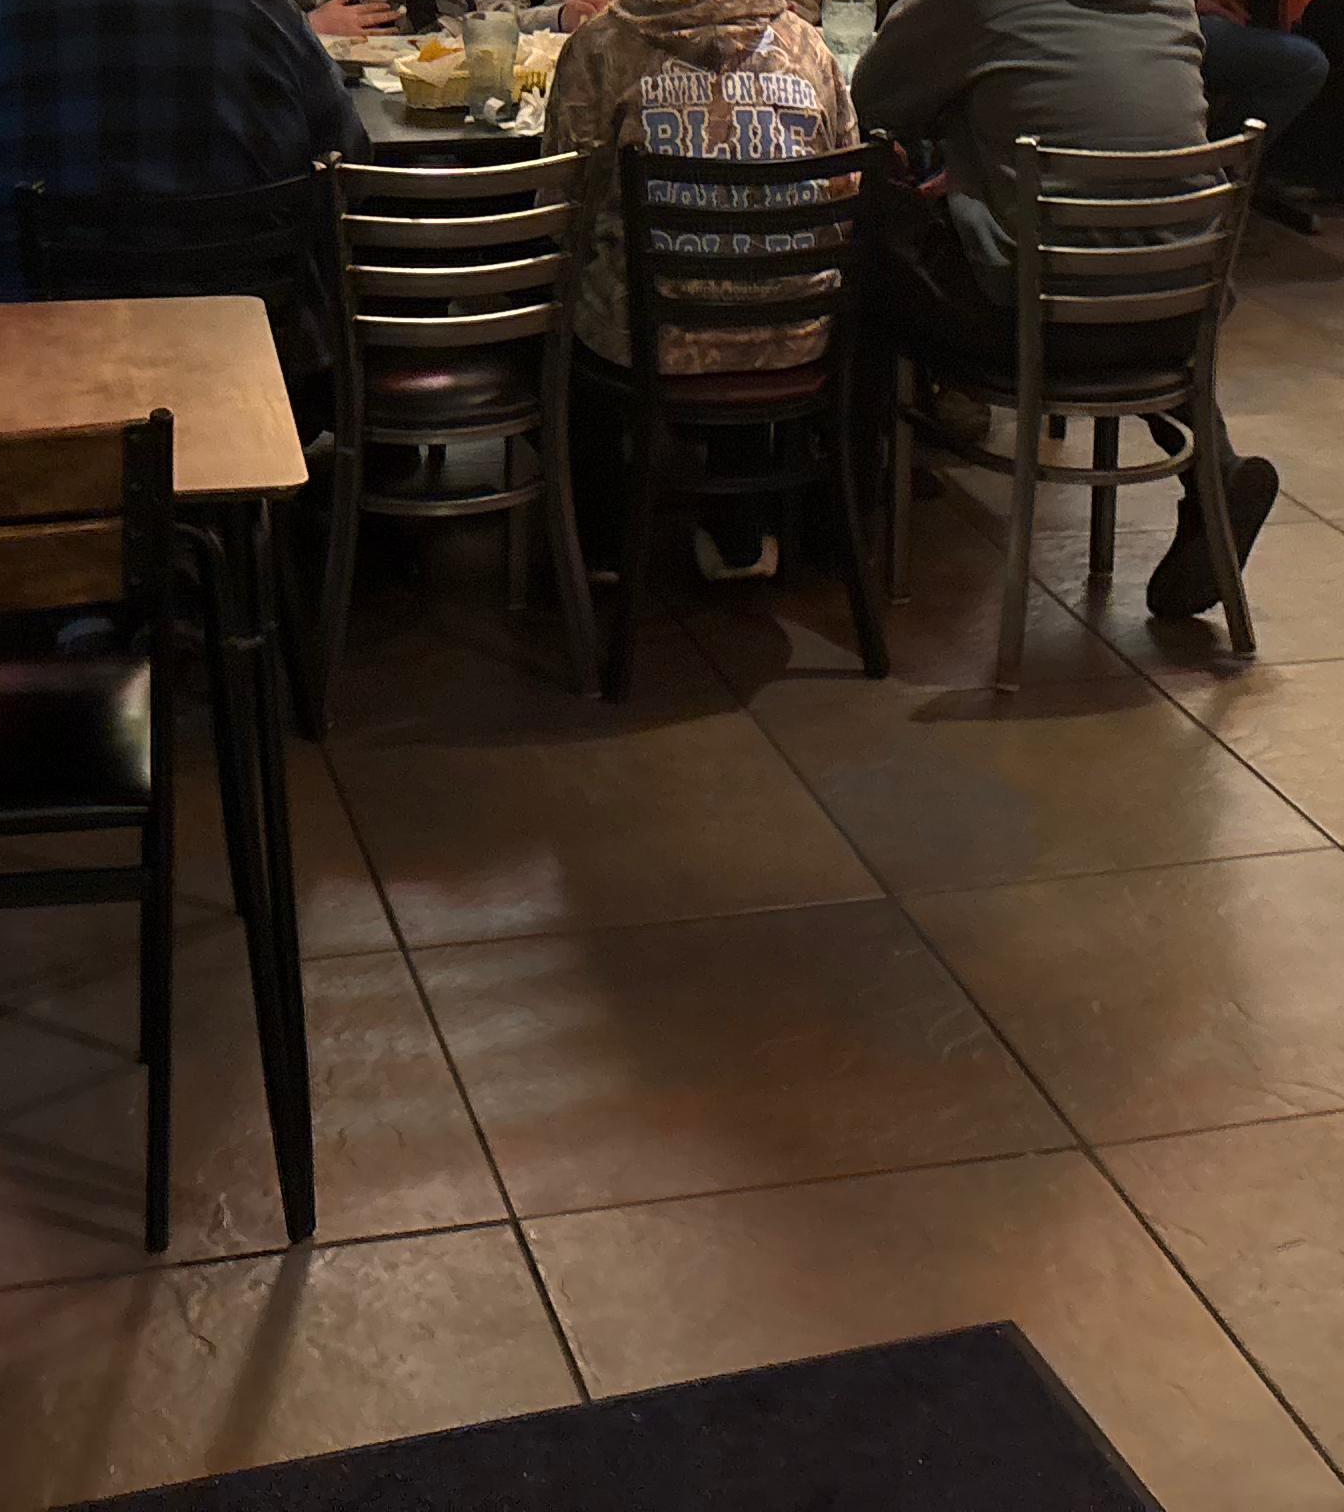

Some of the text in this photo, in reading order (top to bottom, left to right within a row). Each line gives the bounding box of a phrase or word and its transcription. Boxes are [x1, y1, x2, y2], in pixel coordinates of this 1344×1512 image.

[641, 71, 817, 108] LIVIN' ON THAT
[642, 106, 821, 160] BLUE
